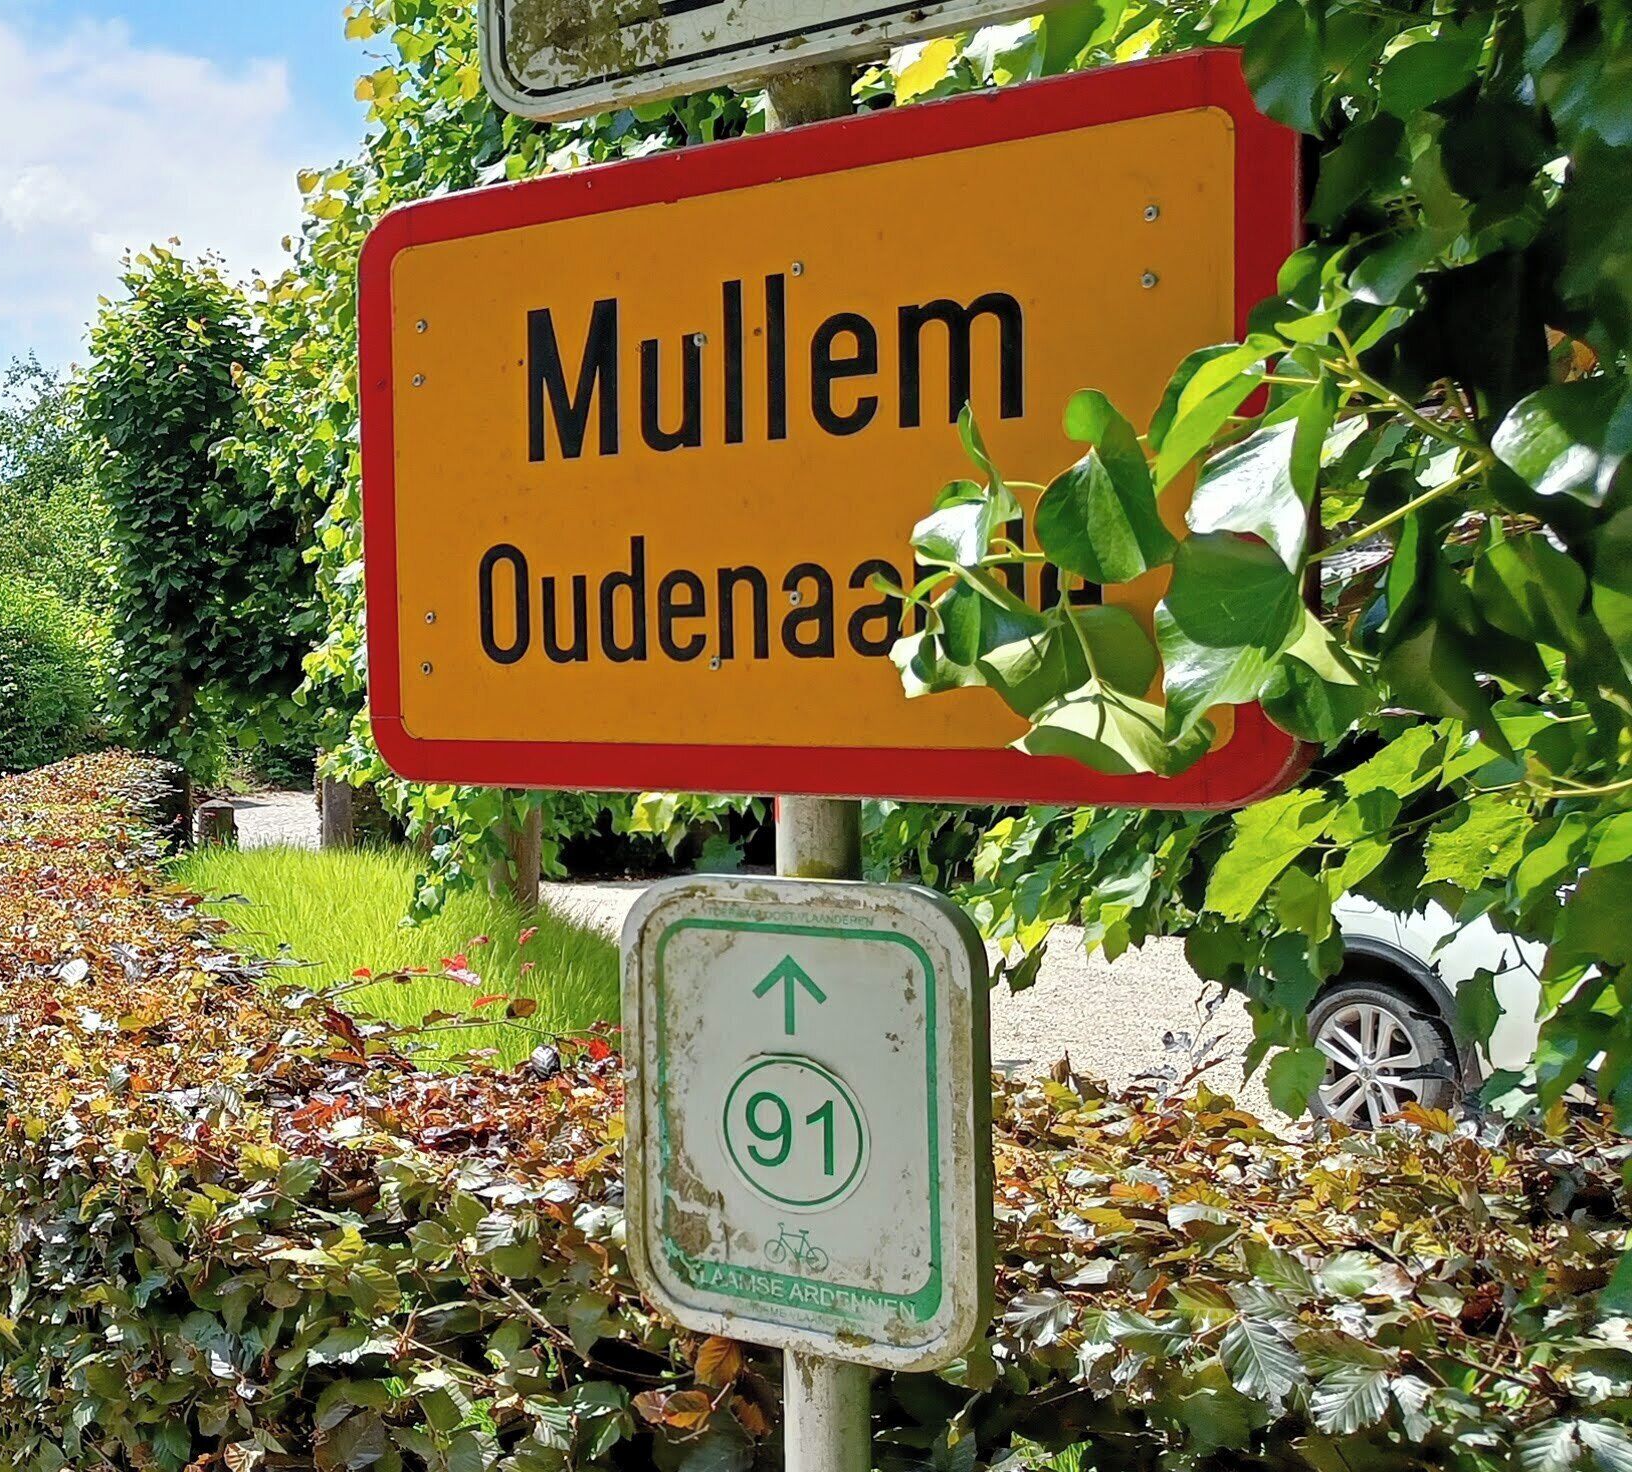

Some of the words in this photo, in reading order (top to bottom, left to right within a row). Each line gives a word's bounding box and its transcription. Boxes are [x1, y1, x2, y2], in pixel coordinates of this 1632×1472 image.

[527, 273, 1024, 463] Mullem
[745, 1091, 834, 1176] 91
[690, 1265, 784, 1298] LAAMSE
[788, 1283, 916, 1322] ARDENNEN
